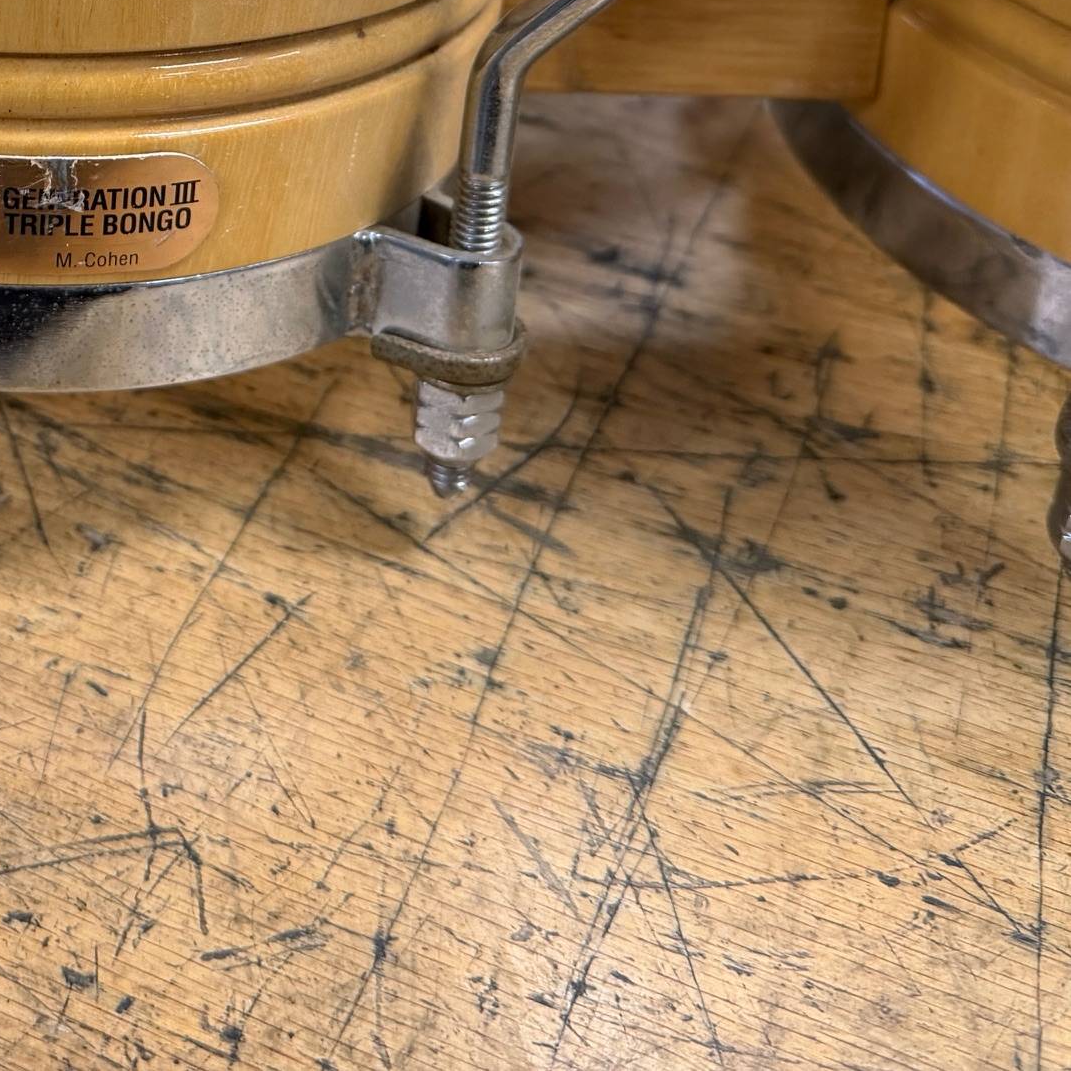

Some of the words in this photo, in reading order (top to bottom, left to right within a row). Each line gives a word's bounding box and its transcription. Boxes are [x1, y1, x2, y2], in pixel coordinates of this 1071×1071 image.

[3, 184, 167, 210] GERATION
[170, 179, 201, 206] III
[4, 212, 95, 236] TRIPLE
[102, 207, 191, 235] BONGO
[56, 252, 77, 268] M.
[84, 251, 139, 268] Cohen
